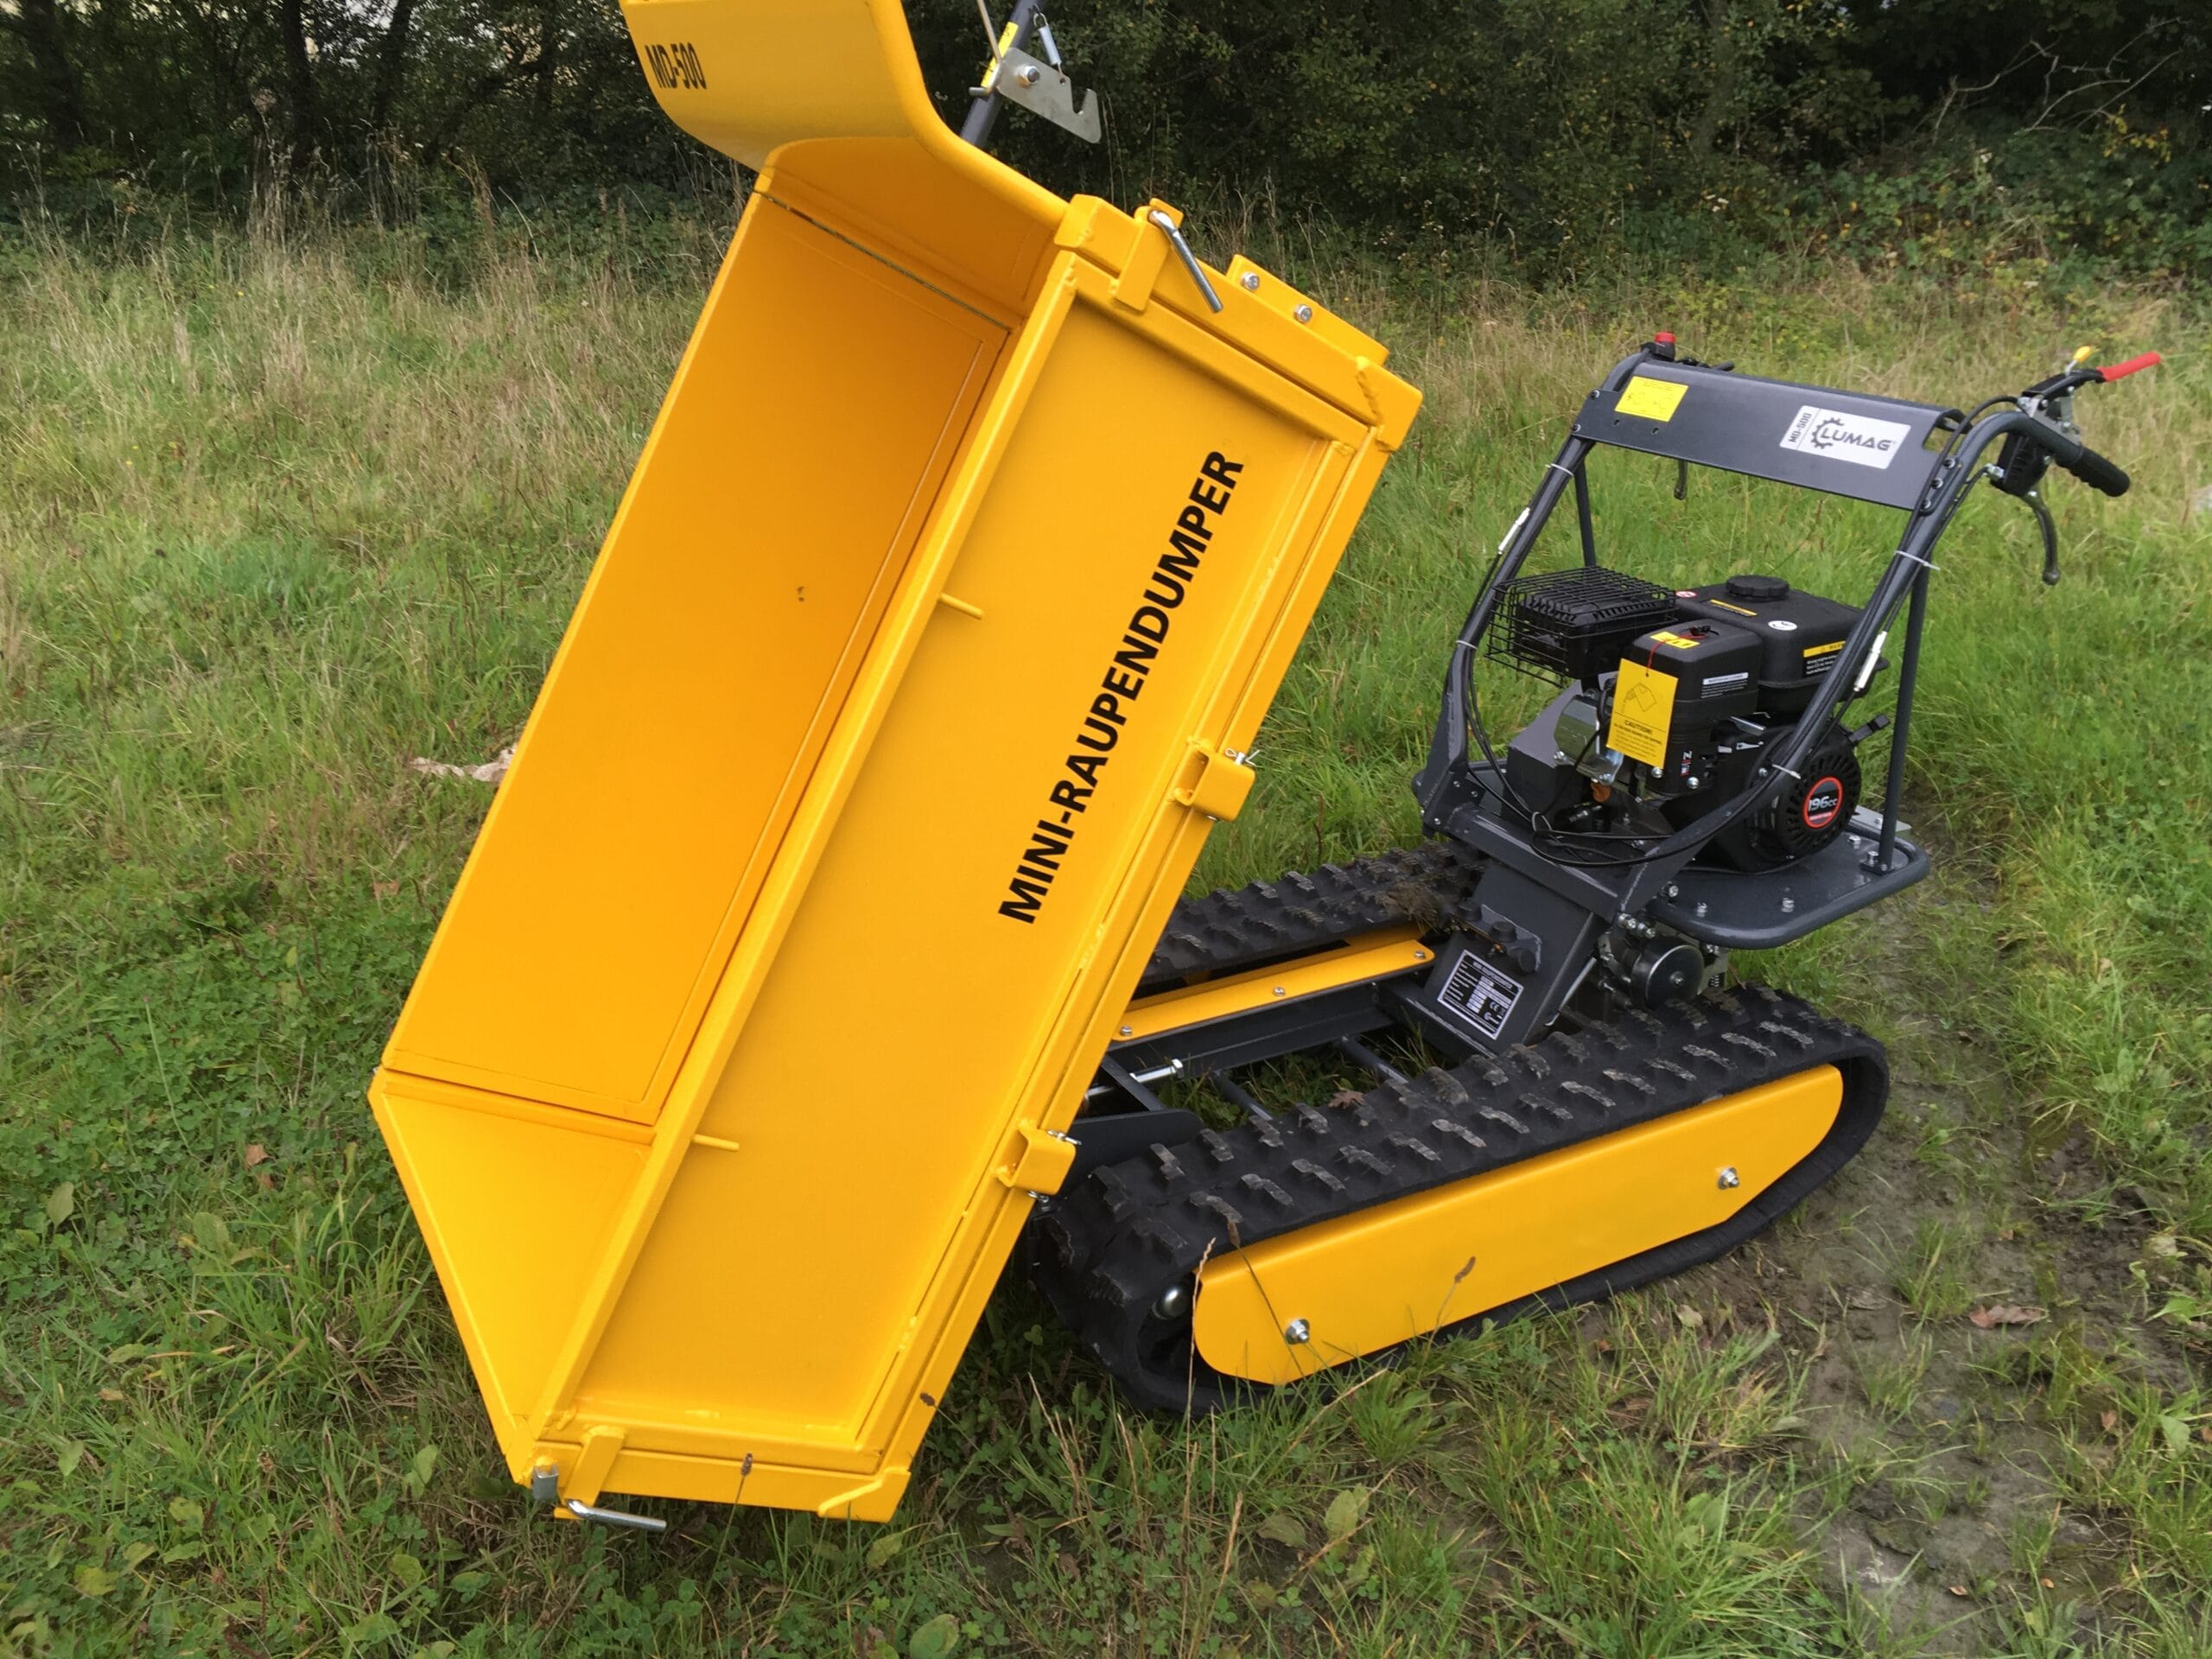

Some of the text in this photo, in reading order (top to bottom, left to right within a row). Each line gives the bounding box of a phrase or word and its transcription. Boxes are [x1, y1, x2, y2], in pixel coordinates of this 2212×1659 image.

[645, 42, 707, 89] MD-500
[1788, 412, 1812, 442] MD-500
[1820, 427, 1892, 451] LUMAG
[998, 450, 1244, 925] MINI-RAUPENDUMPER
